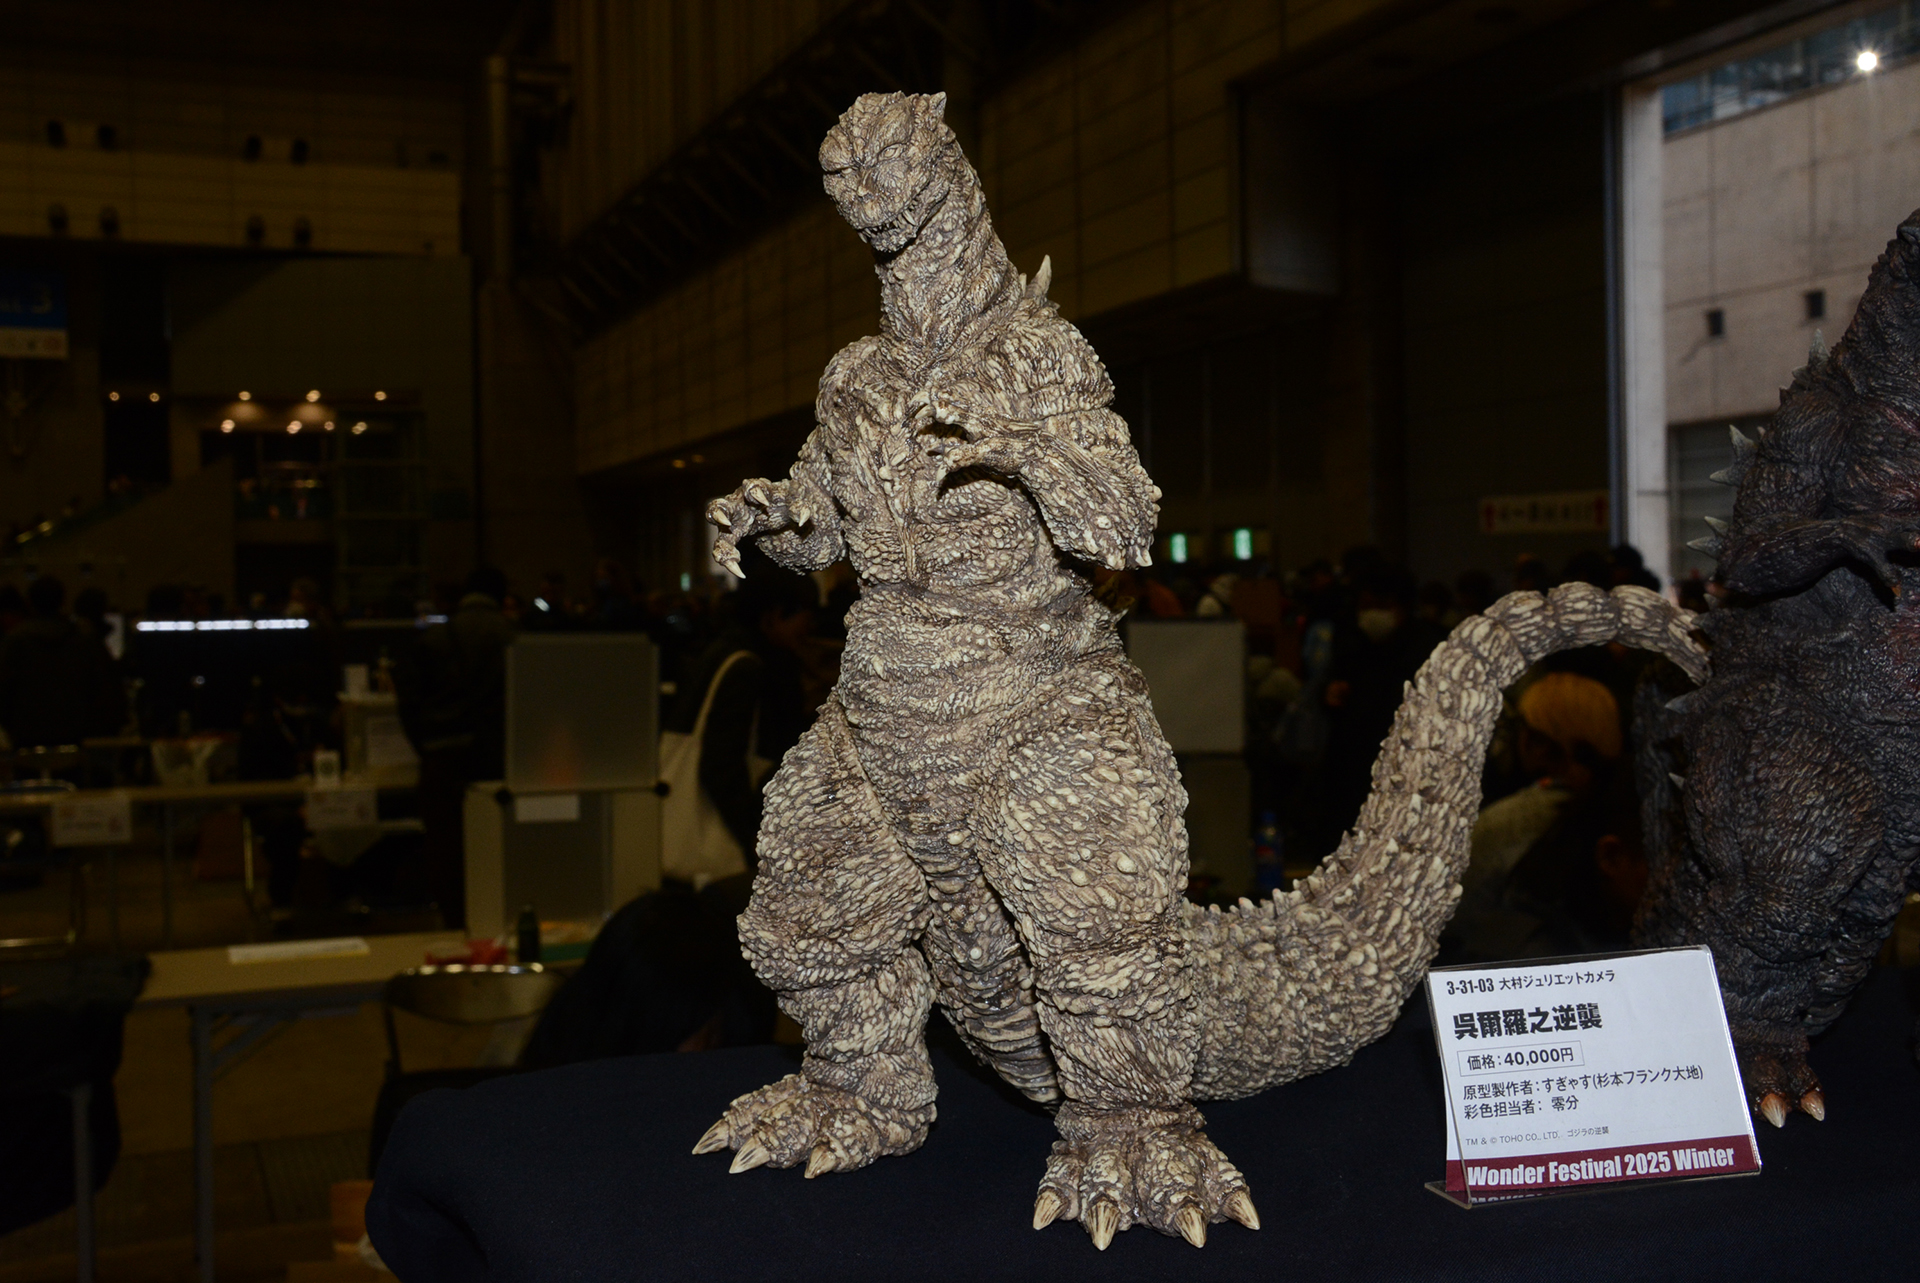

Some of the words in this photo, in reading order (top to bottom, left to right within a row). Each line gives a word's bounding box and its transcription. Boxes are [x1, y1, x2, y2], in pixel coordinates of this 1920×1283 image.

[1446, 978, 1495, 995] 3-31-03
[1499, 970, 1615, 990] 大村ジュリエットカメラ
[1453, 1002, 1602, 1040] 呉爾羅之逆襲
[1551, 1095, 1579, 1112] 零分
[1465, 1138, 1478, 1146] TM
[1480, 1137, 1488, 1145] &
[1500, 1134, 1524, 1144] TOHO
[1567, 1126, 1610, 1138] ゴジラの逆襲
[1467, 1164, 1545, 1186] Wonder
[1548, 1156, 1622, 1182] Festival
[1624, 1151, 1670, 1175] 2025
[1672, 1147, 1735, 1170] Winter
